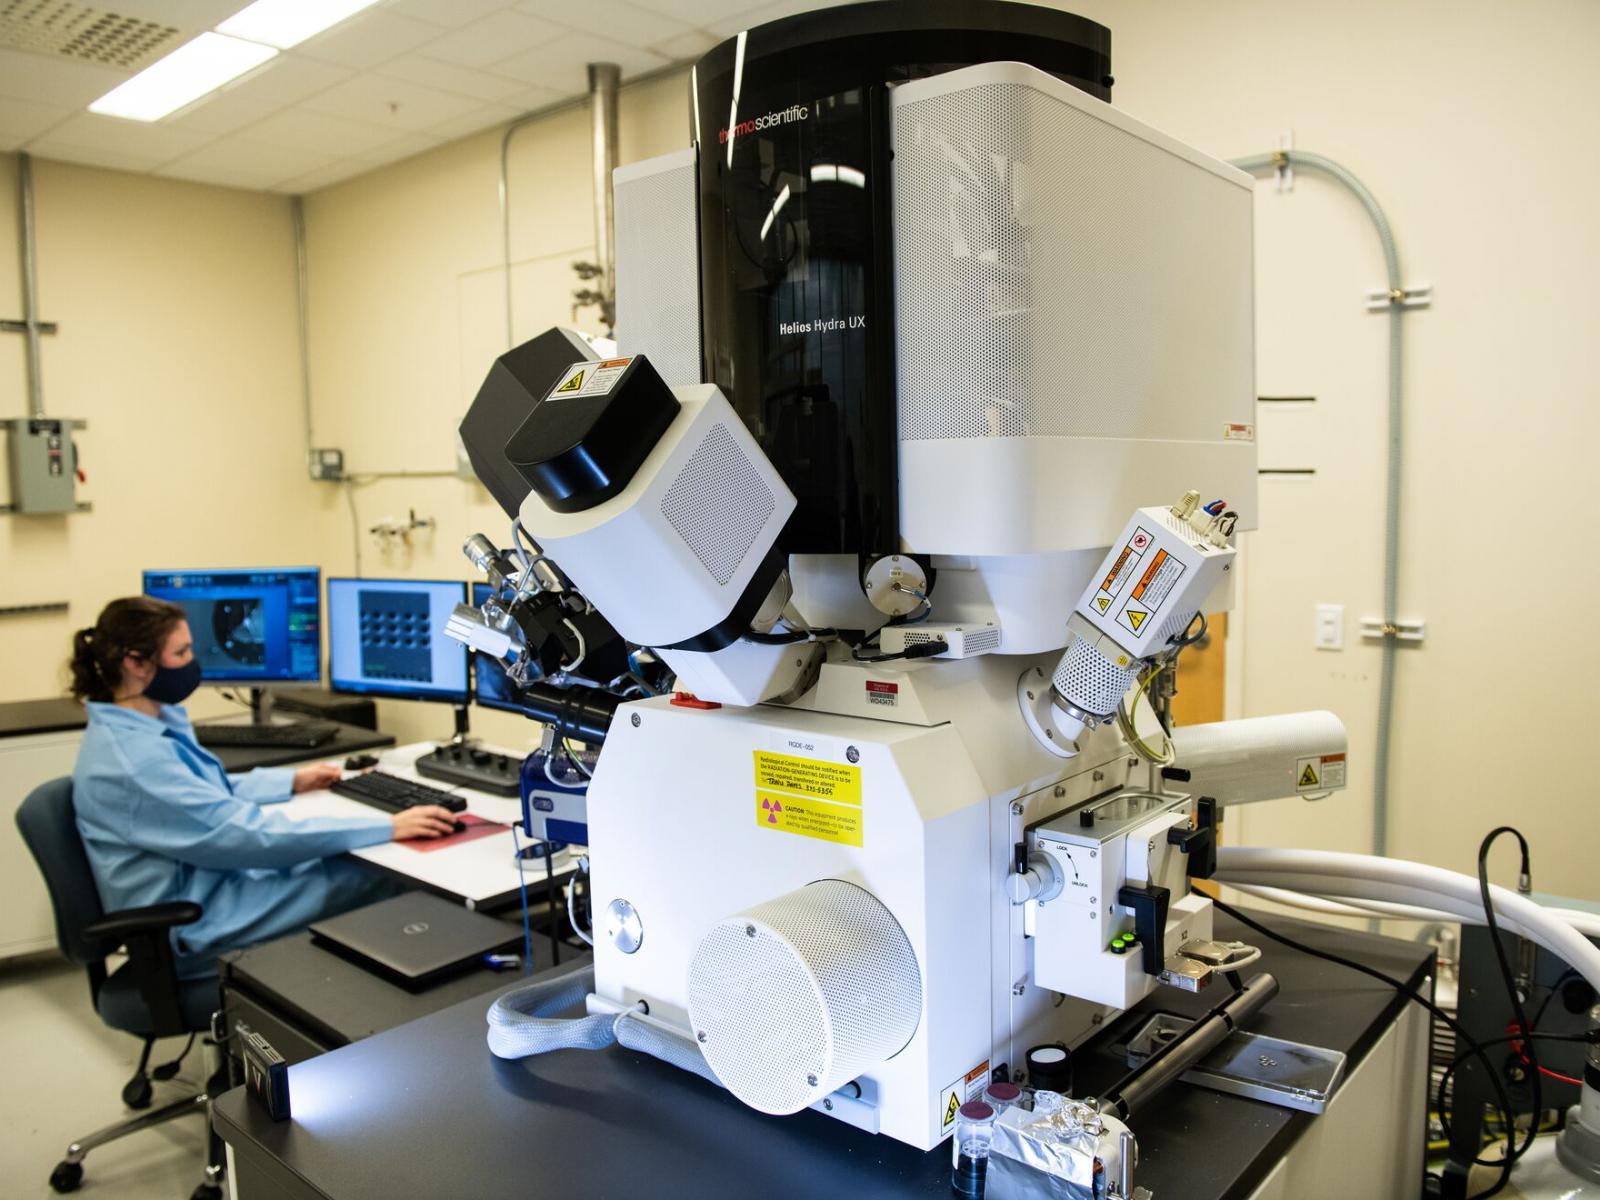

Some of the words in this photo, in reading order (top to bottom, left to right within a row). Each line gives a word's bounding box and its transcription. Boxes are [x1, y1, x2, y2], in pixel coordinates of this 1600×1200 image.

[719, 104, 808, 144] thmoscientific
[780, 321, 811, 336] Helios
[814, 318, 846, 334] Hydra
[848, 316, 866, 328] UX
[1111, 552, 1128, 576] WARNING
